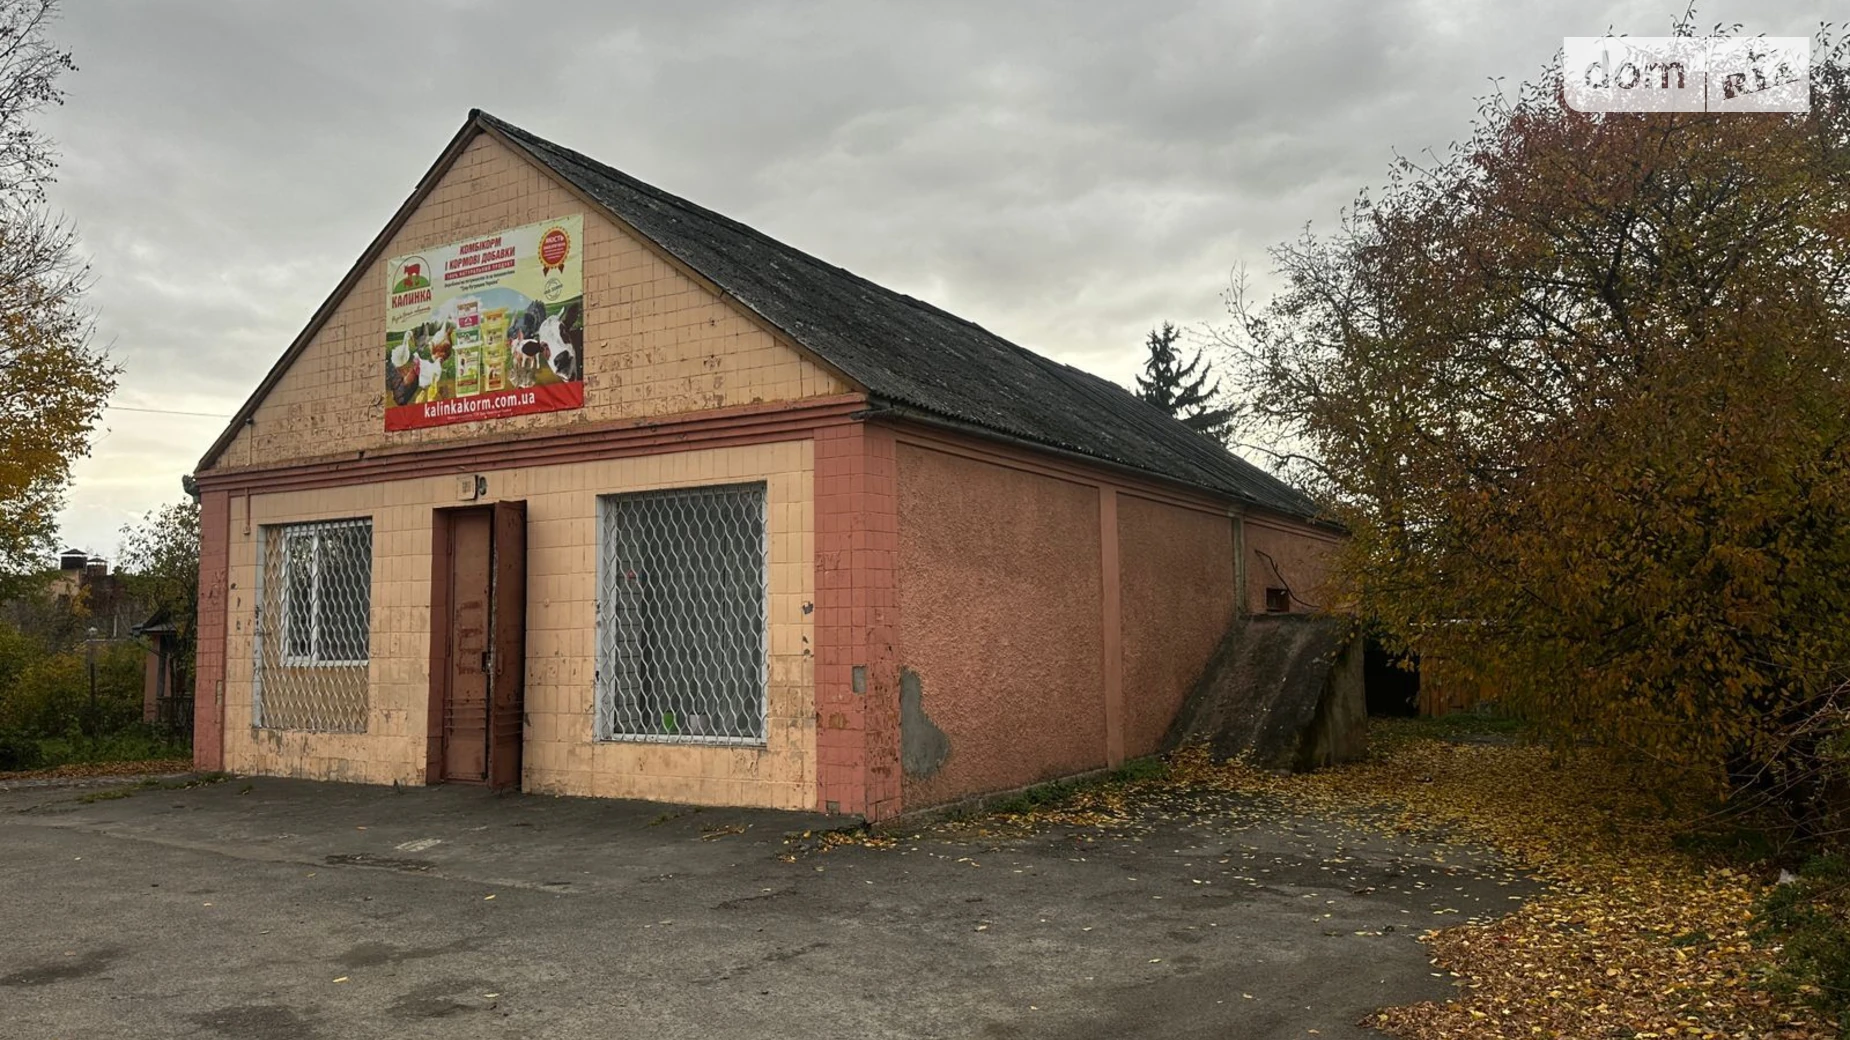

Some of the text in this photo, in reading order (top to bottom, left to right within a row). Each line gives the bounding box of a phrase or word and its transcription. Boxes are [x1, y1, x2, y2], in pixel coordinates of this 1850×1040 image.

[460, 236, 501, 255] КОМБІКОРМ
[449, 254, 480, 270] КОРМОВІ
[481, 246, 515, 264] ДОБАВКИ
[392, 289, 431, 308] КАЛИНКА
[424, 392, 535, 418] kalinkakorm.com.ua
